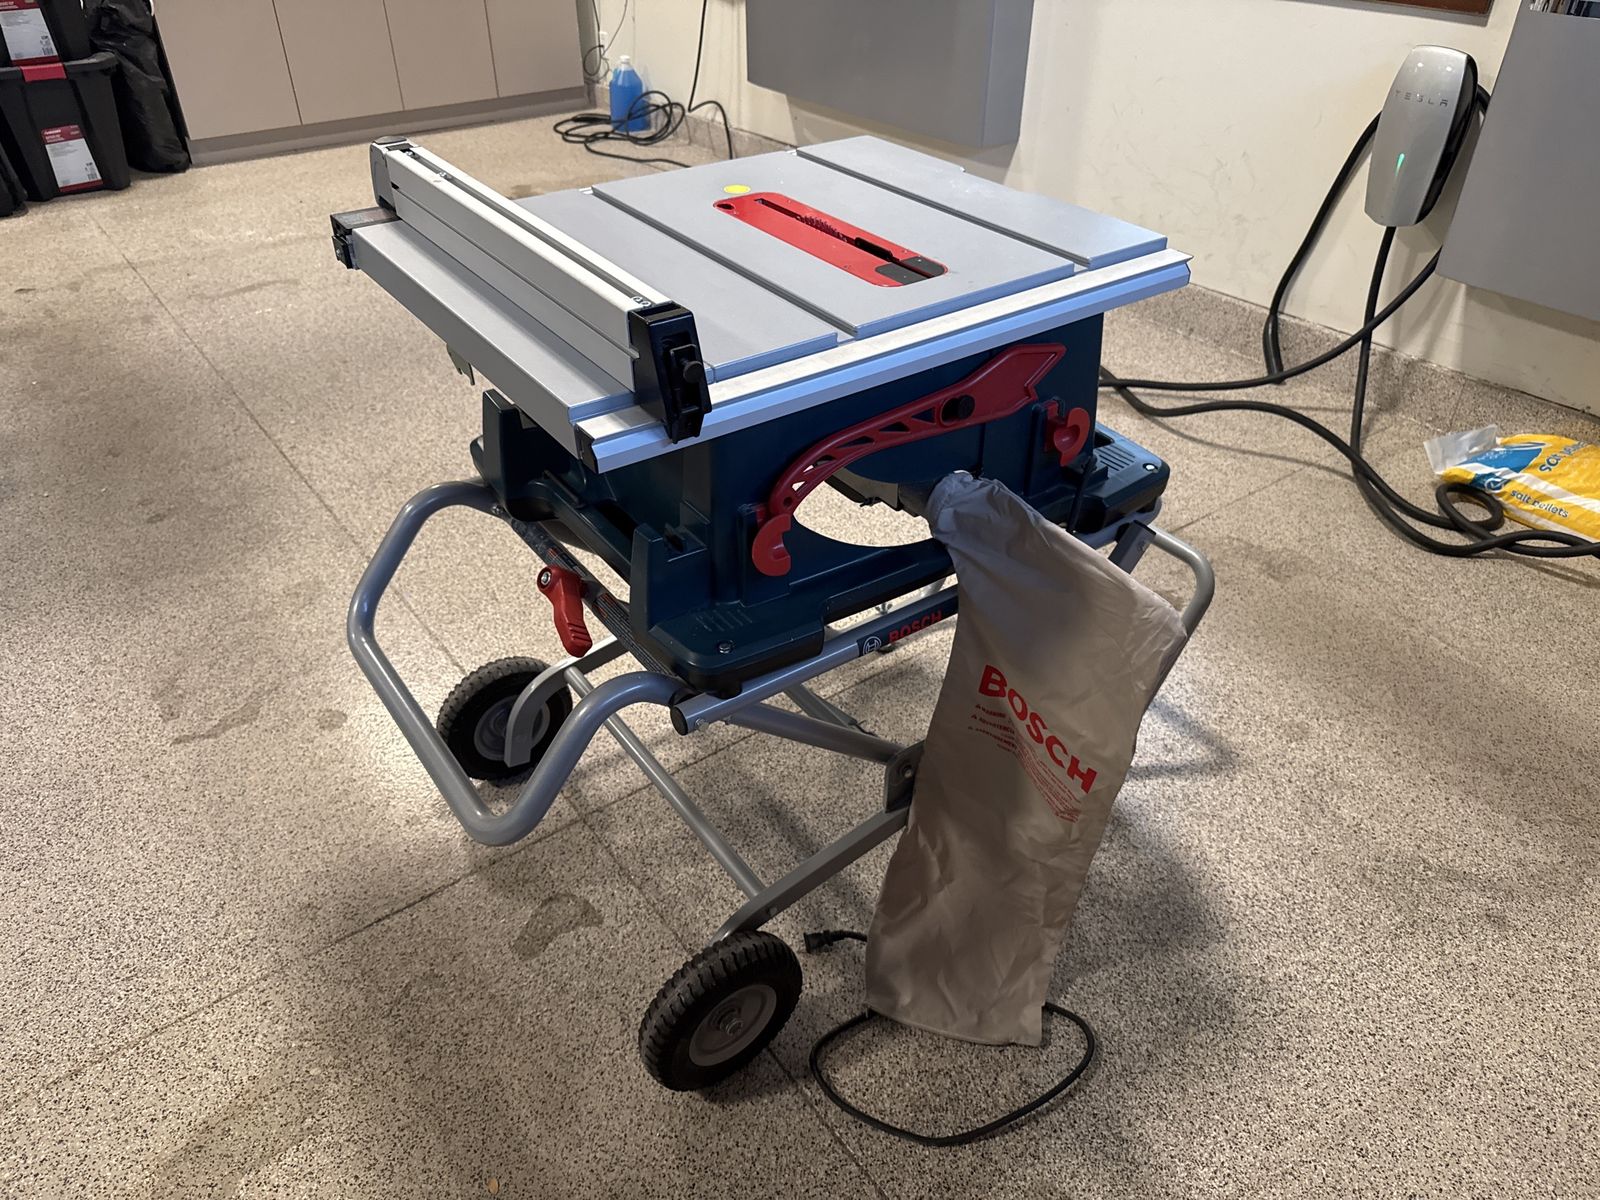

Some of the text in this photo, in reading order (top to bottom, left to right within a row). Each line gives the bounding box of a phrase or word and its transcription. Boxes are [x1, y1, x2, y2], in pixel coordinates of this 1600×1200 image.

[1395, 90, 1448, 107] TESLA
[1511, 490, 1569, 518] salt pellets
[888, 609, 944, 643] BOSCH
[978, 664, 1097, 794] BOSCH
